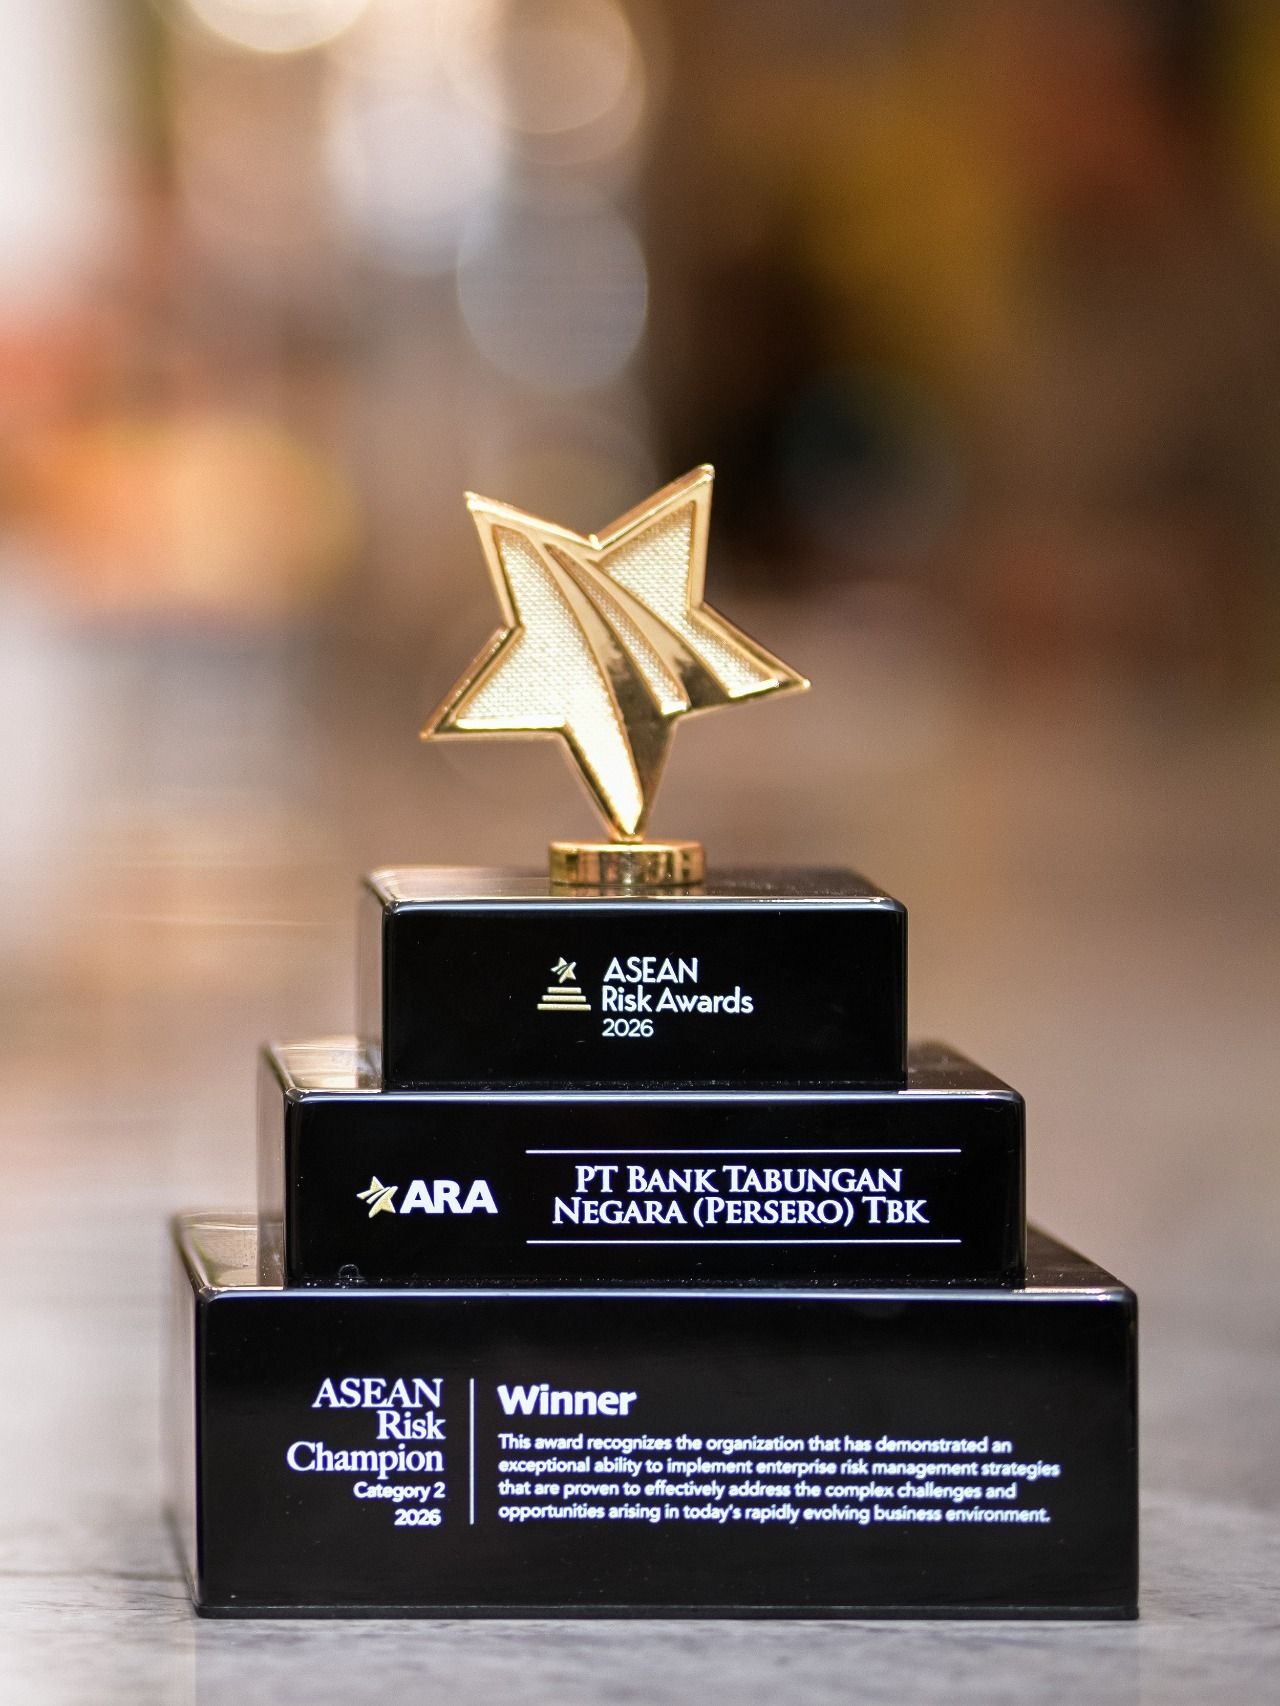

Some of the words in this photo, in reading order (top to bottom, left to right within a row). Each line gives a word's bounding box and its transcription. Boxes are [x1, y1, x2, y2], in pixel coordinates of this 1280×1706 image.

[604, 957, 698, 983] ASEAN
[602, 985, 652, 1012] Risk
[656, 986, 754, 1013] Awards
[602, 1018, 654, 1037] 2026
[575, 1165, 618, 1192] PT
[627, 1166, 719, 1193] BANK
[722, 1165, 902, 1192] TABUNGAN
[400, 1180, 498, 1213] ARA
[552, 1197, 688, 1224] NEGARA
[694, 1197, 854, 1227] (PERSERO)
[862, 1196, 929, 1224] TBK
[312, 1377, 443, 1410] ASEAN
[497, 1383, 637, 1416] Winner
[376, 1409, 446, 1441] Risk
[497, 1433, 532, 1450] This
[534, 1433, 583, 1450] award
[587, 1435, 672, 1454] recognizes
[675, 1434, 702, 1450] the
[706, 1435, 804, 1454] organization
[808, 1435, 841, 1451] that
[844, 1435, 872, 1452] has
[875, 1435, 989, 1453] demonstrated
[991, 1440, 1012, 1453] an
[286, 1441, 444, 1478] Champion
[498, 1456, 590, 1476] exceptional
[594, 1456, 643, 1477] ability
[645, 1459, 663, 1473] to
[667, 1457, 753, 1477] implement
[756, 1458, 837, 1478] enterprise
[841, 1458, 869, 1475] risk
[872, 1462, 979, 1479] management
[981, 1460, 1061, 1481] strategies
[353, 1481, 431, 1503] Category
[433, 1482, 446, 1498] 2
[498, 1479, 531, 1495] that
[534, 1482, 560, 1496] are
[563, 1483, 619, 1500] proven
[623, 1482, 641, 1496] to
[644, 1479, 726, 1500] effectively
[728, 1480, 791, 1497] address
[794, 1480, 821, 1497] the
[825, 1481, 894, 1502] complex
[897, 1481, 982, 1503] challenges
[985, 1482, 1017, 1499] and
[394, 1508, 442, 1527] 2026
[498, 1503, 606, 1523] opportunities
[608, 1503, 661, 1523] arising
[664, 1503, 679, 1519] in
[744, 1504, 800, 1524] rapidly
[803, 1504, 870, 1525] evolving
[874, 1504, 942, 1521] business
[945, 1506, 1051, 1523] environment.
